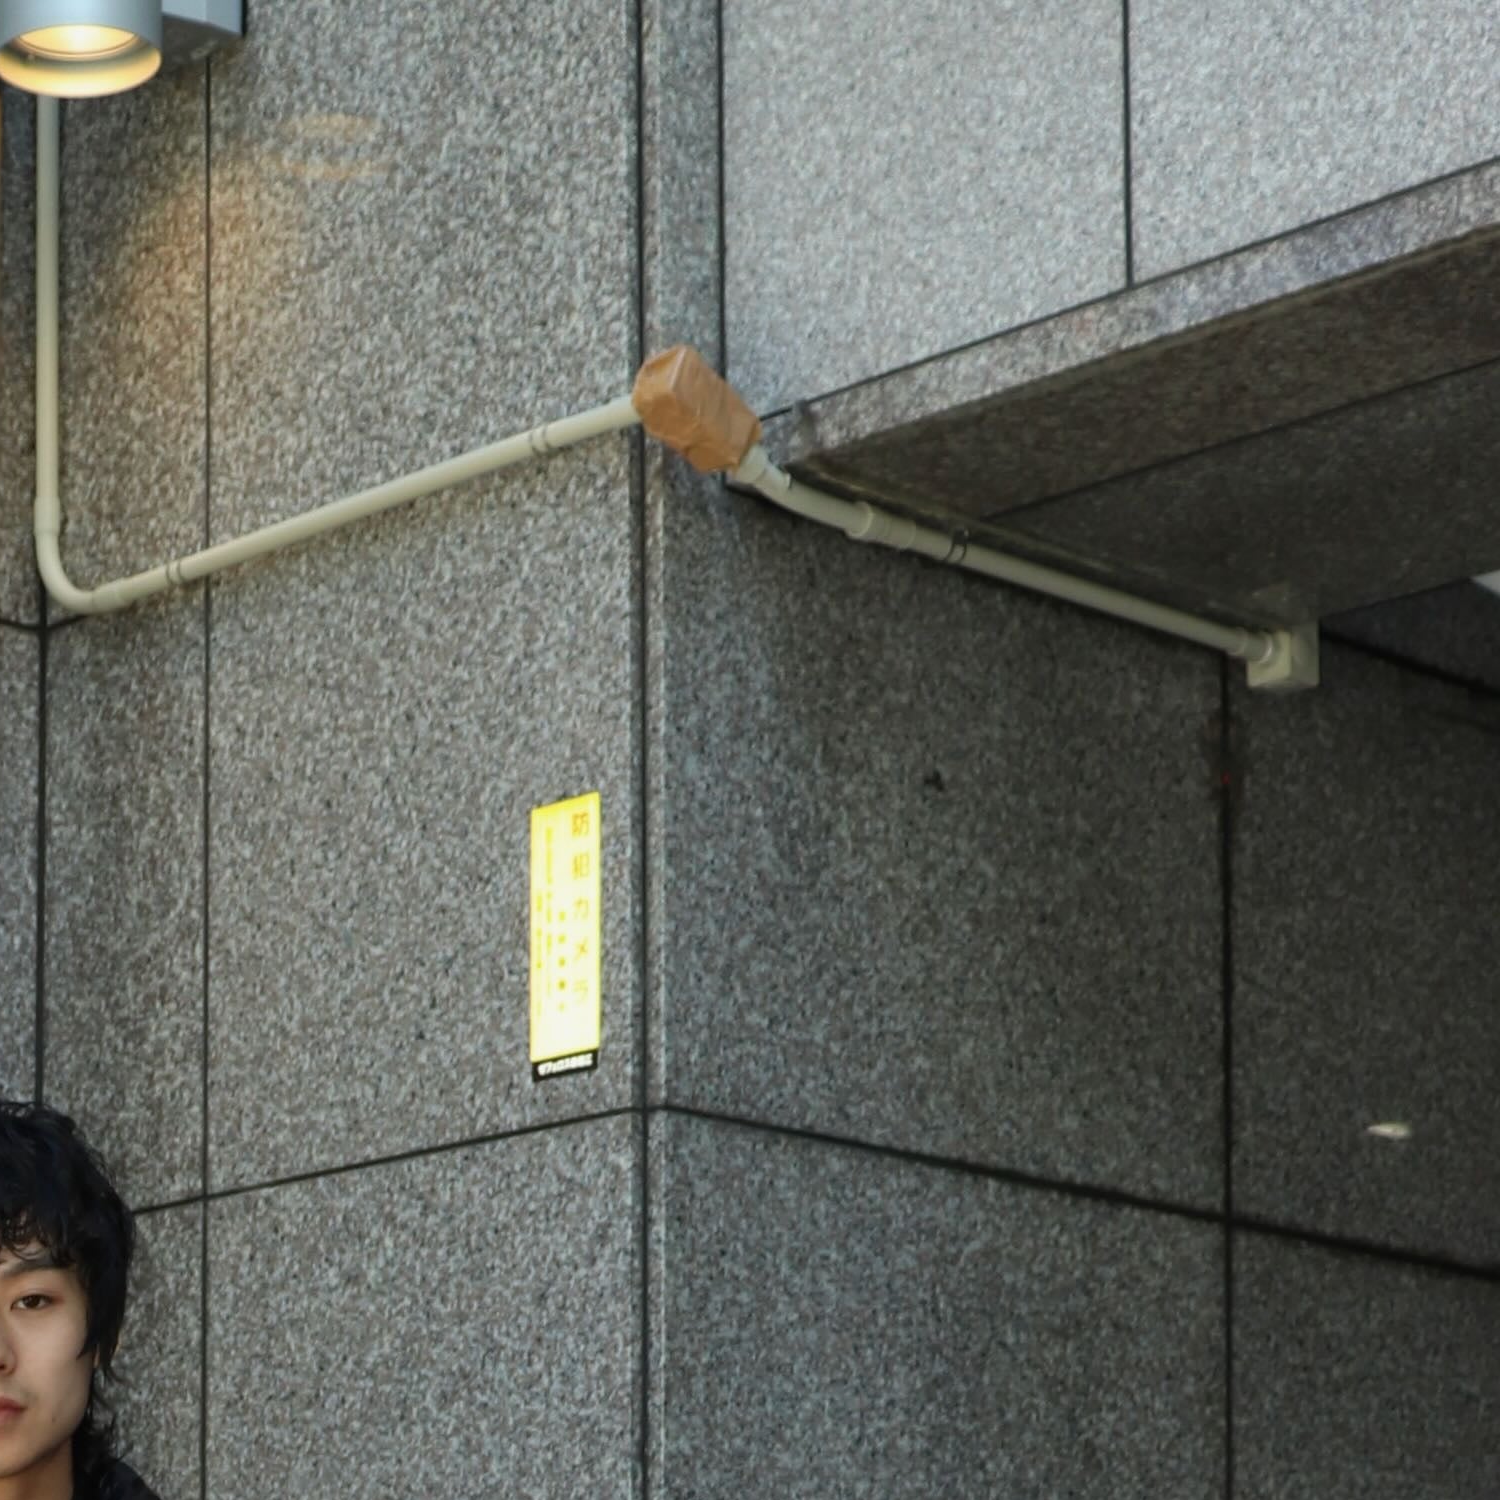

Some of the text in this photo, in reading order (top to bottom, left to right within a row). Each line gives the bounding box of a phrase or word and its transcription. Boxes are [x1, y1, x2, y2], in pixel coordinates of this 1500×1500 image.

[571, 811, 591, 1002] 防犯カメラ
